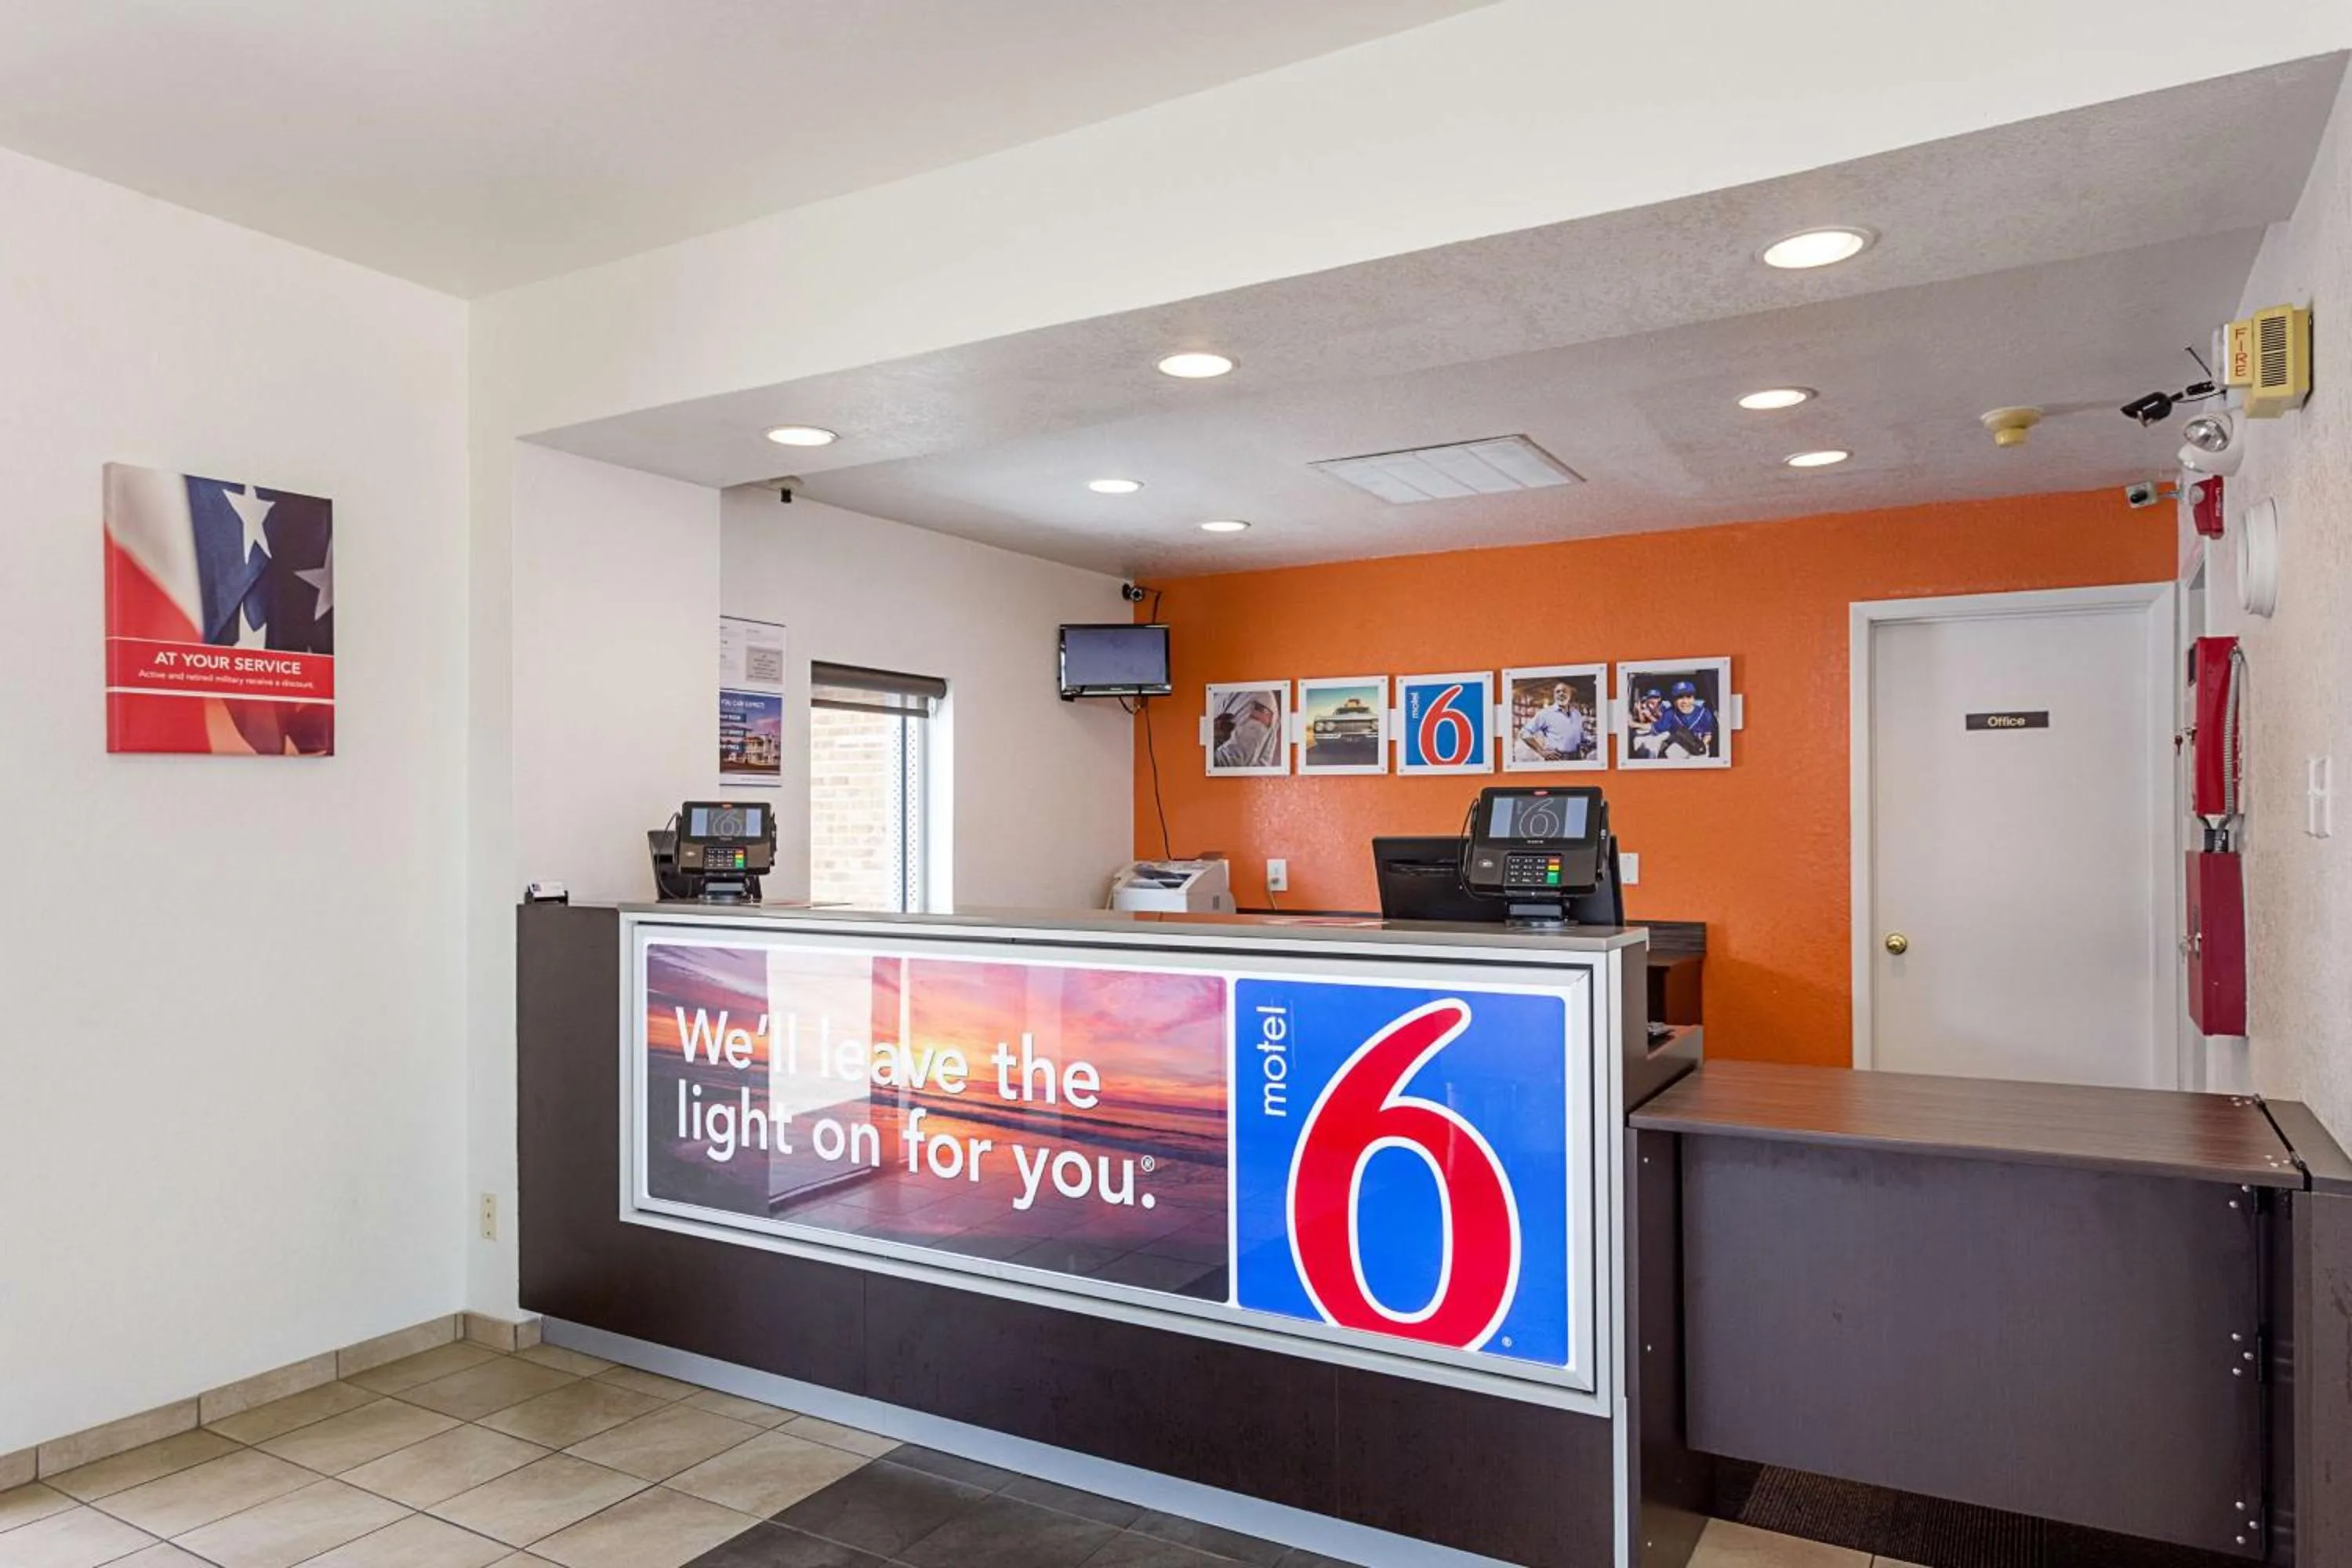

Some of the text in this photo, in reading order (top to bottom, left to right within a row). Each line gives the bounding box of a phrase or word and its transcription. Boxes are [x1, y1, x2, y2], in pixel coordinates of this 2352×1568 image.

[2235, 327, 2248, 377] FIRE
[138, 669, 165, 680] Active
[168, 672, 184, 681] and
[186, 673, 214, 682] retired
[215, 675, 243, 686] military
[245, 677, 274, 686] receive
[154, 652, 302, 674] AT YOUR SERVICE
[1418, 684, 1475, 766] 6
[1987, 716, 2026, 728] Office
[675, 1006, 1101, 1110] We'll leave the
[677, 1078, 793, 1163] light
[811, 1116, 880, 1168] on
[902, 1106, 993, 1182] for
[1256, 997, 1522, 1352] motel 6
